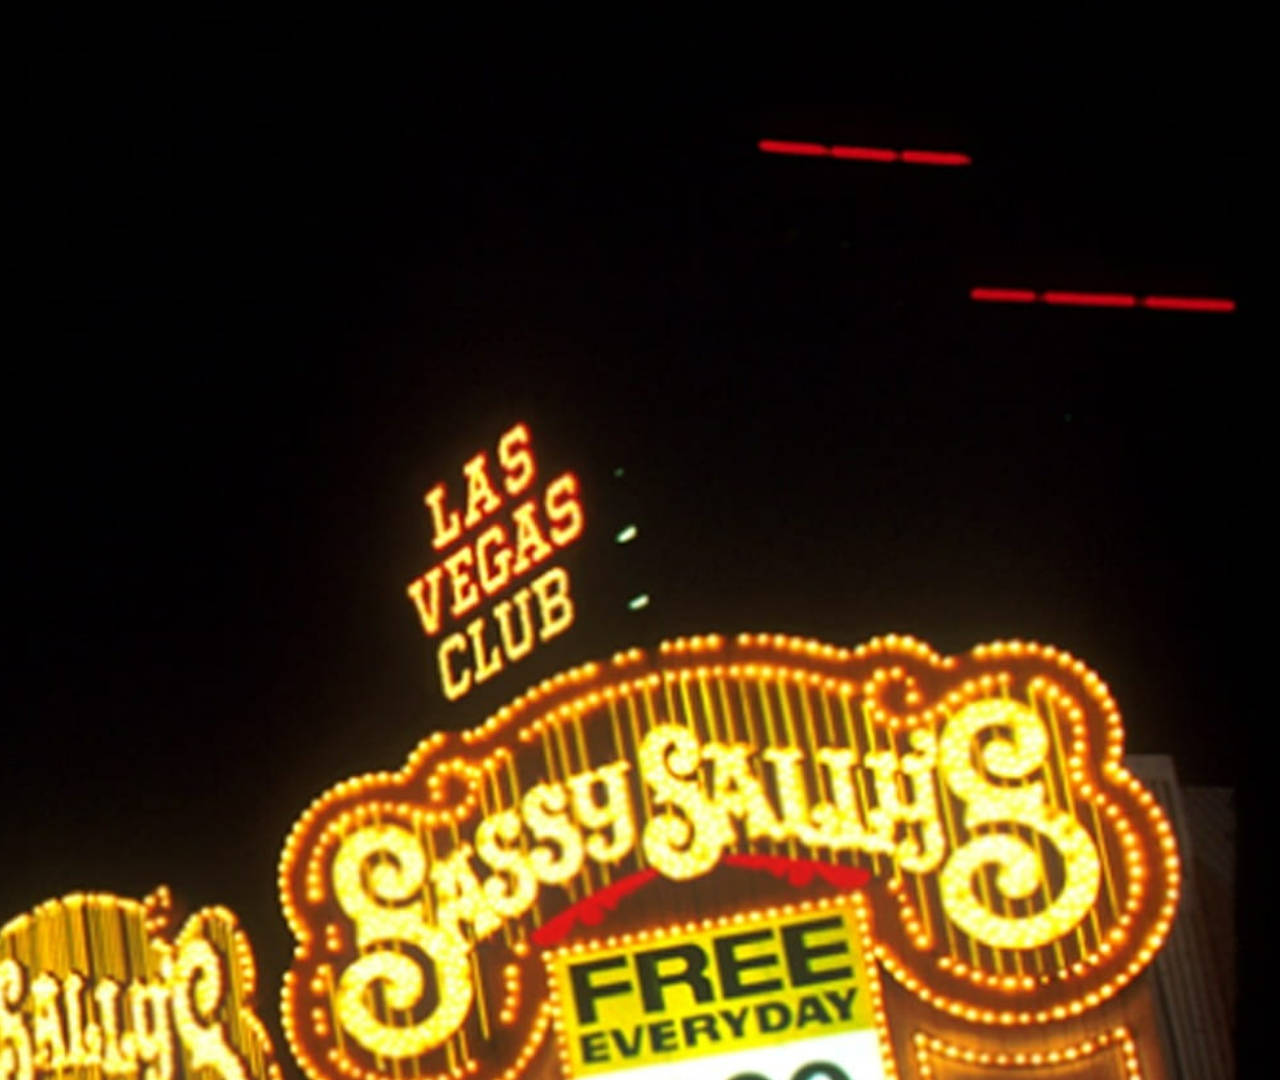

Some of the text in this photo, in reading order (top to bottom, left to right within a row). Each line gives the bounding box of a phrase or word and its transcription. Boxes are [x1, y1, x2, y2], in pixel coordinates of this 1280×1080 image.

[424, 421, 537, 550] LAS
[406, 470, 585, 636] VEGAS
[437, 566, 575, 701] CLUB
[567, 914, 855, 1027] FREE
[578, 987, 859, 1065] EVERYDAY
